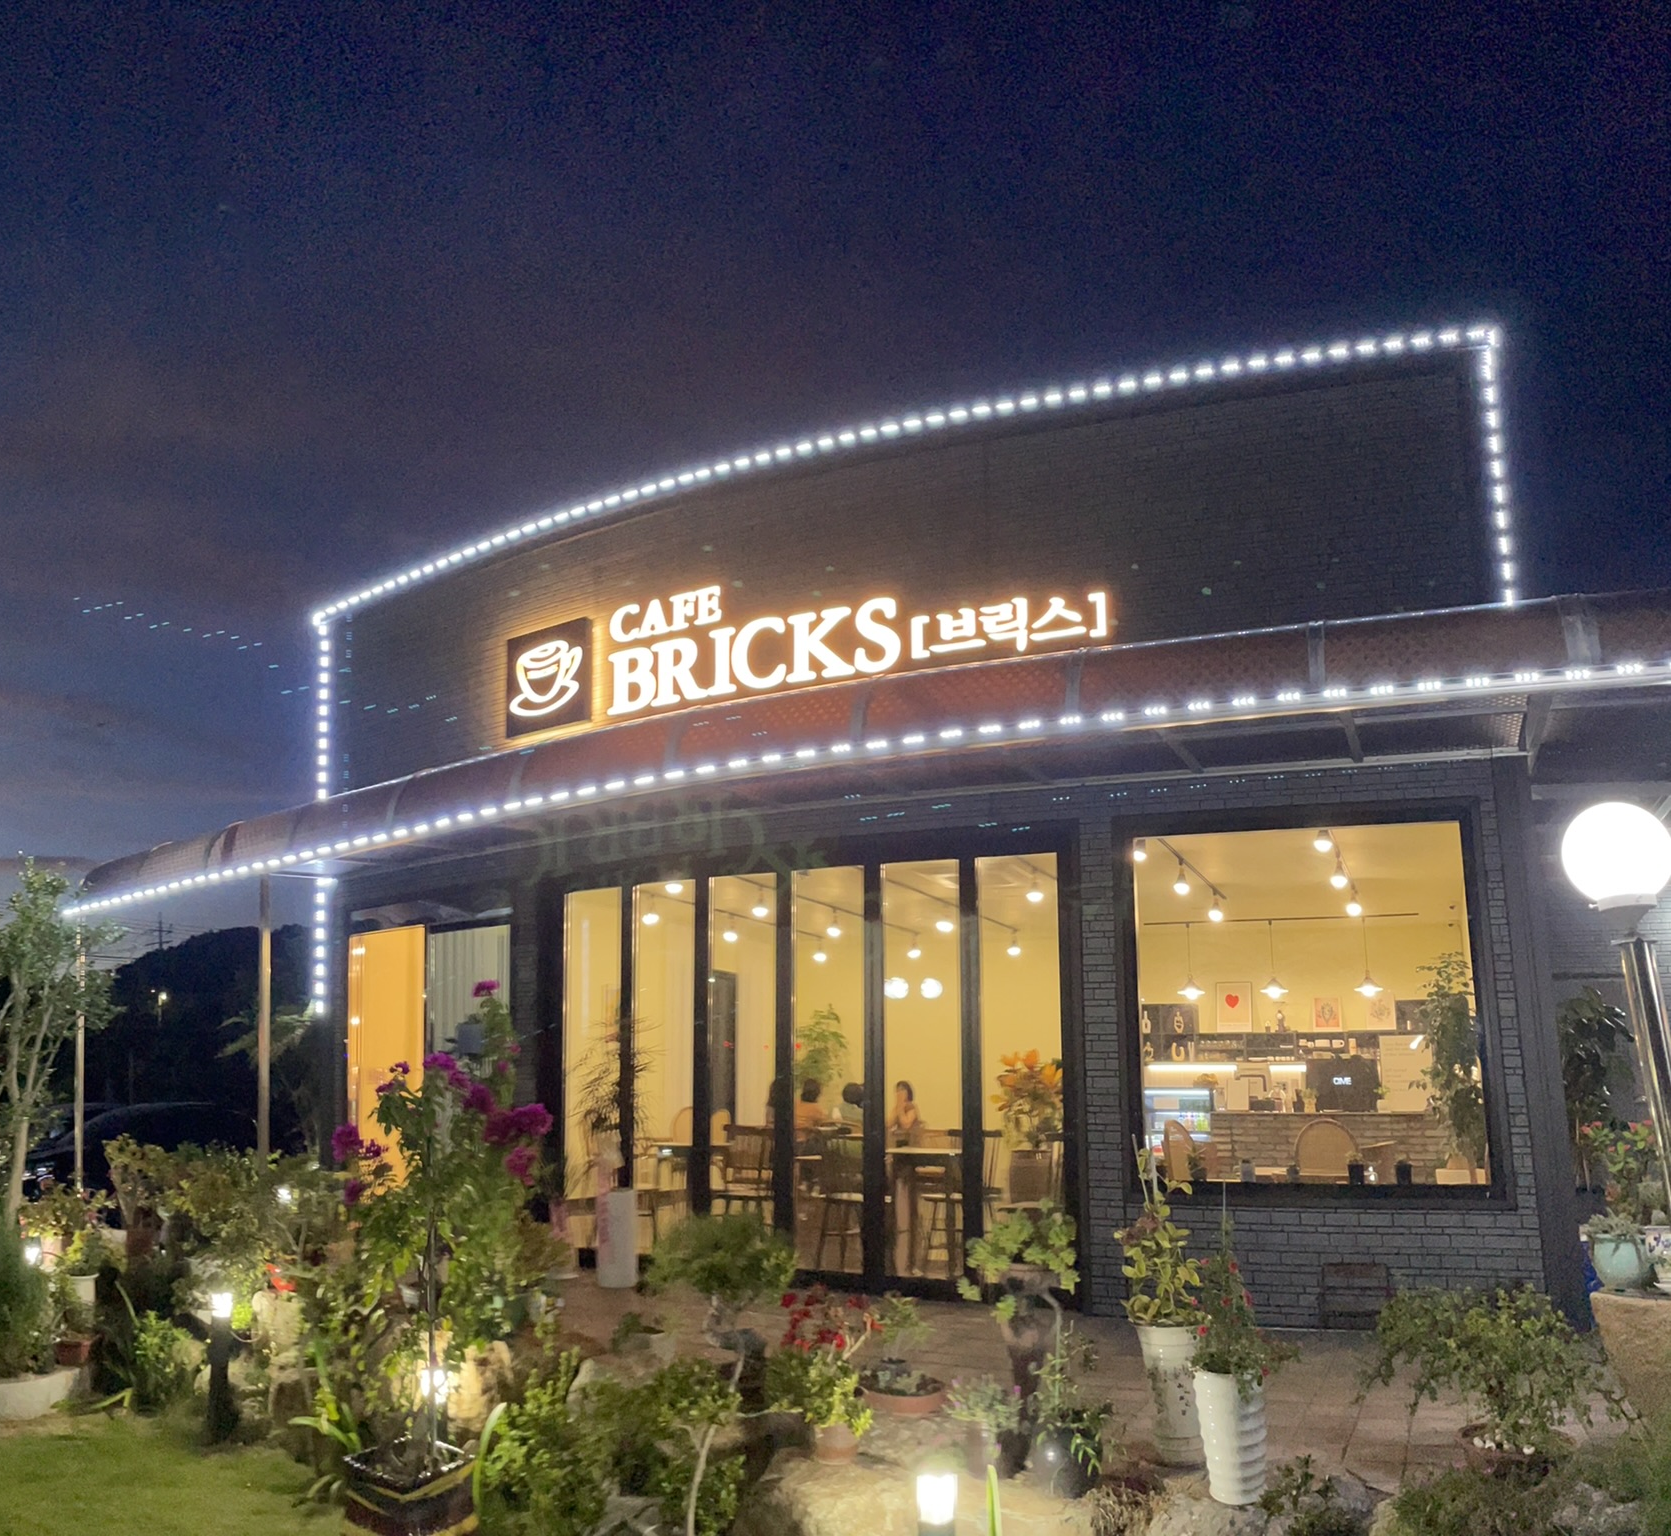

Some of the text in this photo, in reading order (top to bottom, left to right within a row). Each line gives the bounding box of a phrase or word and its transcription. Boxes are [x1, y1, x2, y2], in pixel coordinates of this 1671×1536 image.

[606, 591, 1107, 717] BRICKS [브릭스]
[609, 585, 722, 643] CAFE
